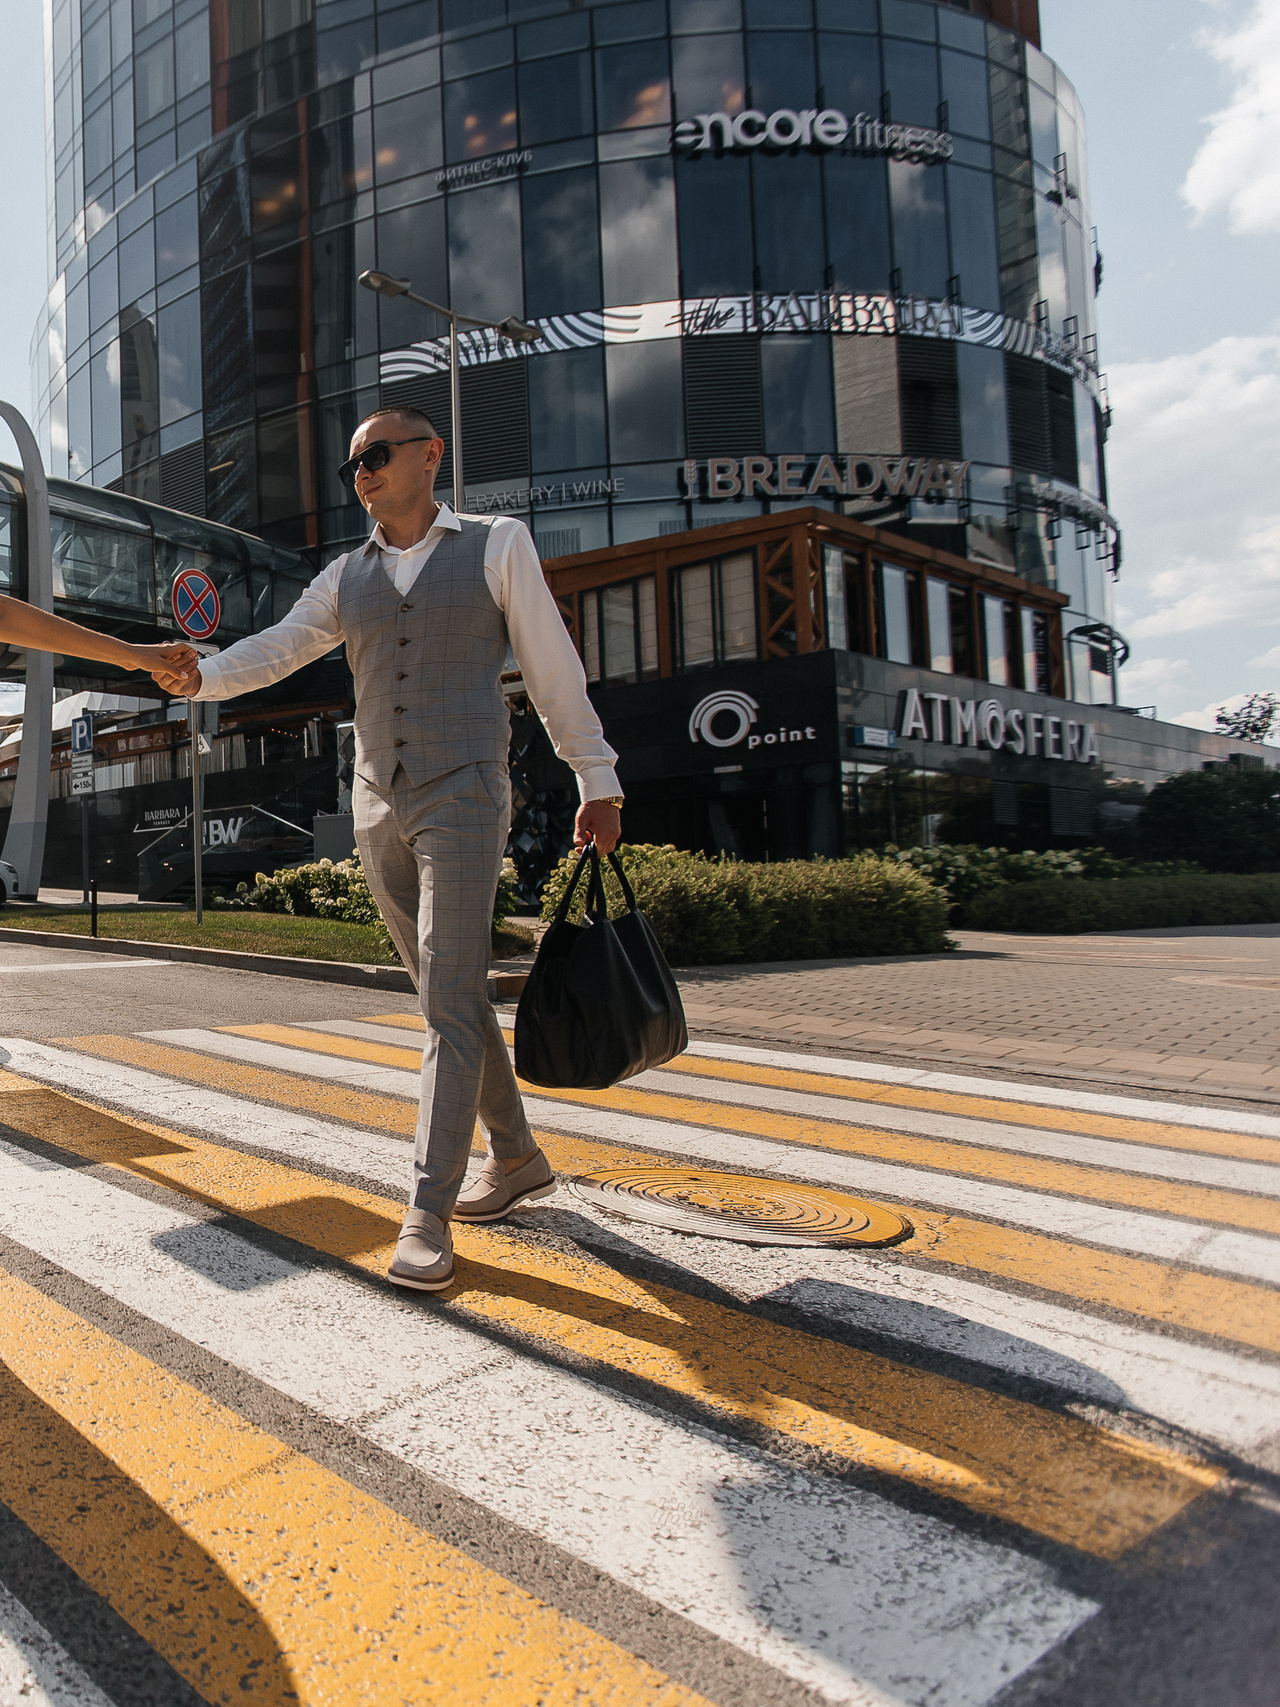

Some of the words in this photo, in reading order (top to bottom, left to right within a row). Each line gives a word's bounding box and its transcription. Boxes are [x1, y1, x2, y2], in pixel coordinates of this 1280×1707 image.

[675, 108, 849, 150] encore
[851, 111, 954, 158] fitness
[435, 149, 533, 181] ФИТНЕС-КЛУБ
[707, 454, 971, 498] BREADWAY
[476, 485, 556, 509] BAKERY
[573, 477, 626, 496] WINE
[75, 720, 88, 749] P
[748, 724, 817, 749] point
[900, 687, 1100, 764] ATMOSFERA
[144, 807, 181, 821] BARBARA
[209, 817, 244, 846] BW
